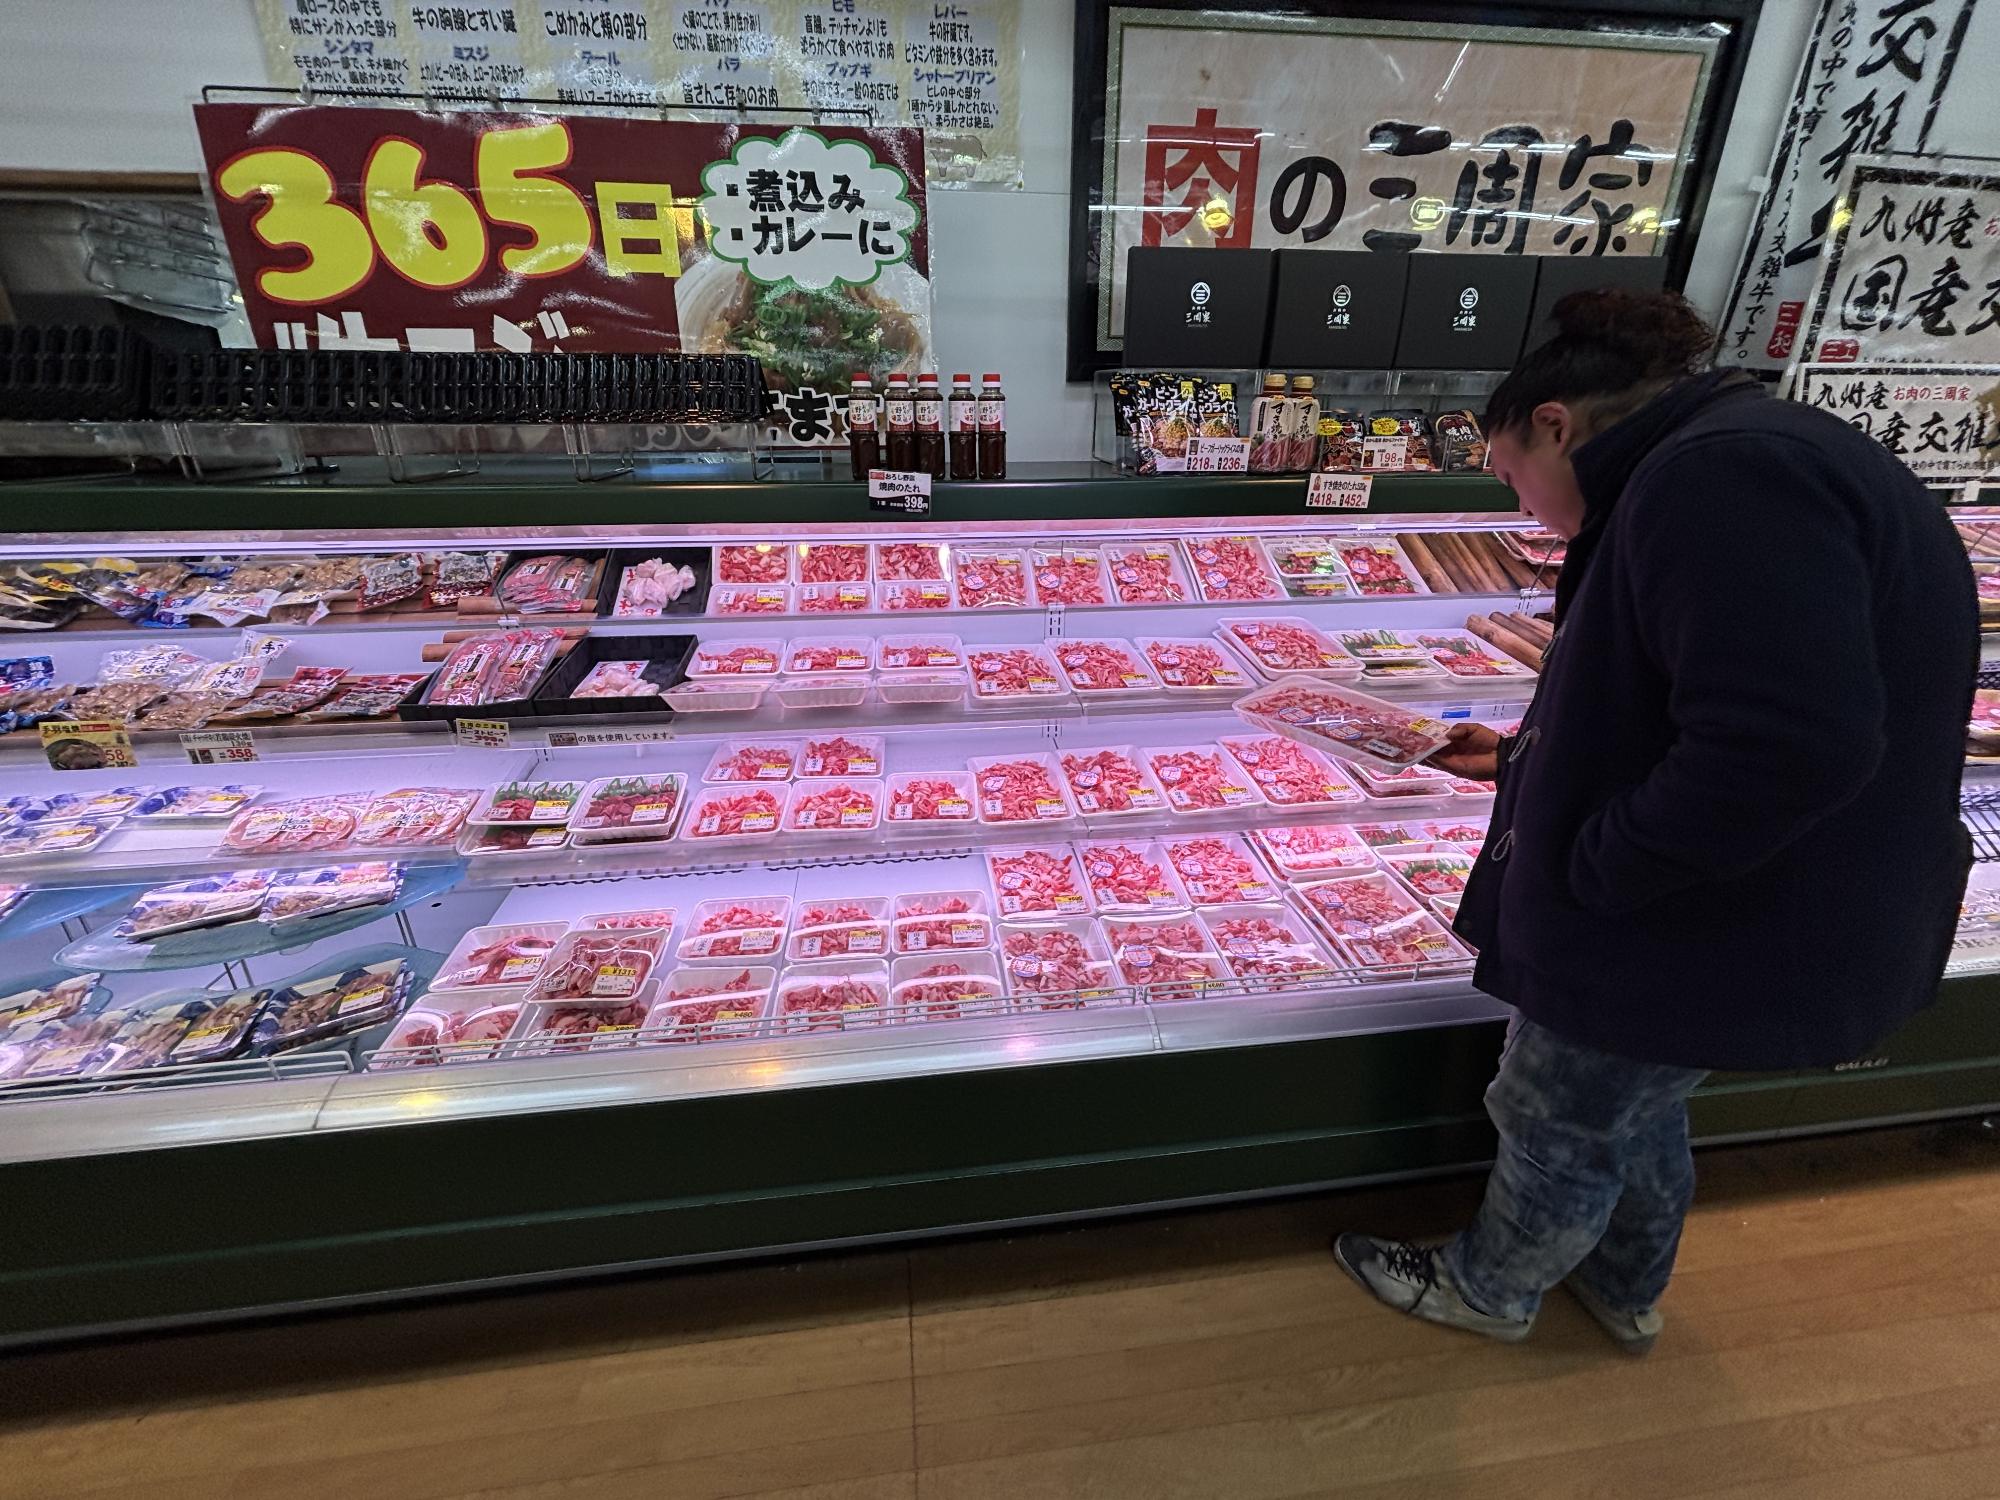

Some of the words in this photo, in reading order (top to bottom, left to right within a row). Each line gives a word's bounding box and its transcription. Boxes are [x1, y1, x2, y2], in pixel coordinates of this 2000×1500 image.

[934, 4, 968, 19] レバー
[581, 51, 621, 66] テール
[913, 67, 996, 85] シャトーブリアン
[218, 122, 683, 304] 365日
[1892, 386, 1972, 401] お肉の三周家
[879, 482, 921, 493] 焼肉のたれ
